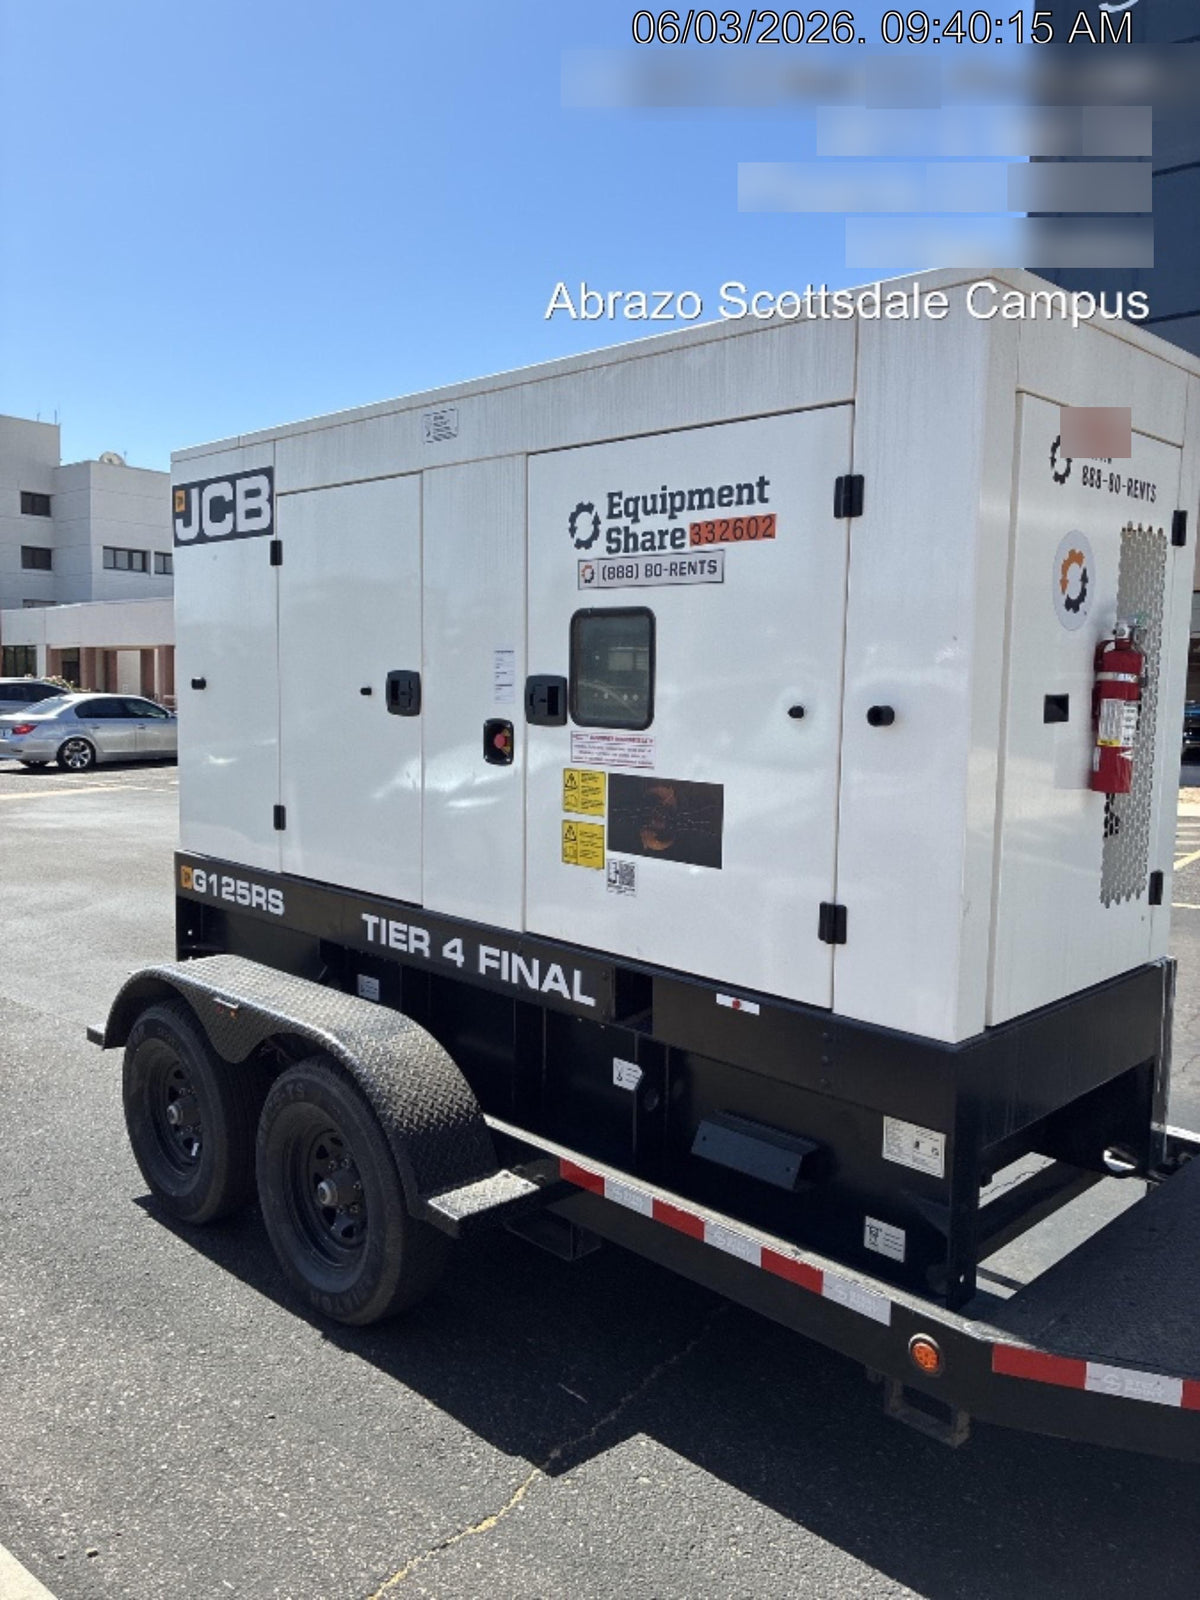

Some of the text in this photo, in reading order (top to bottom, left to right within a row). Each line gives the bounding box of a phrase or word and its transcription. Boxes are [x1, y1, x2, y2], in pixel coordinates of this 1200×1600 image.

[175, 474, 272, 541] JCB
[606, 475, 770, 524] Equipment
[605, 525, 687, 555] Share
[691, 515, 774, 546] 332602
[192, 868, 285, 916] G125RS
[361, 912, 596, 1007] TIER 4 FINAL
